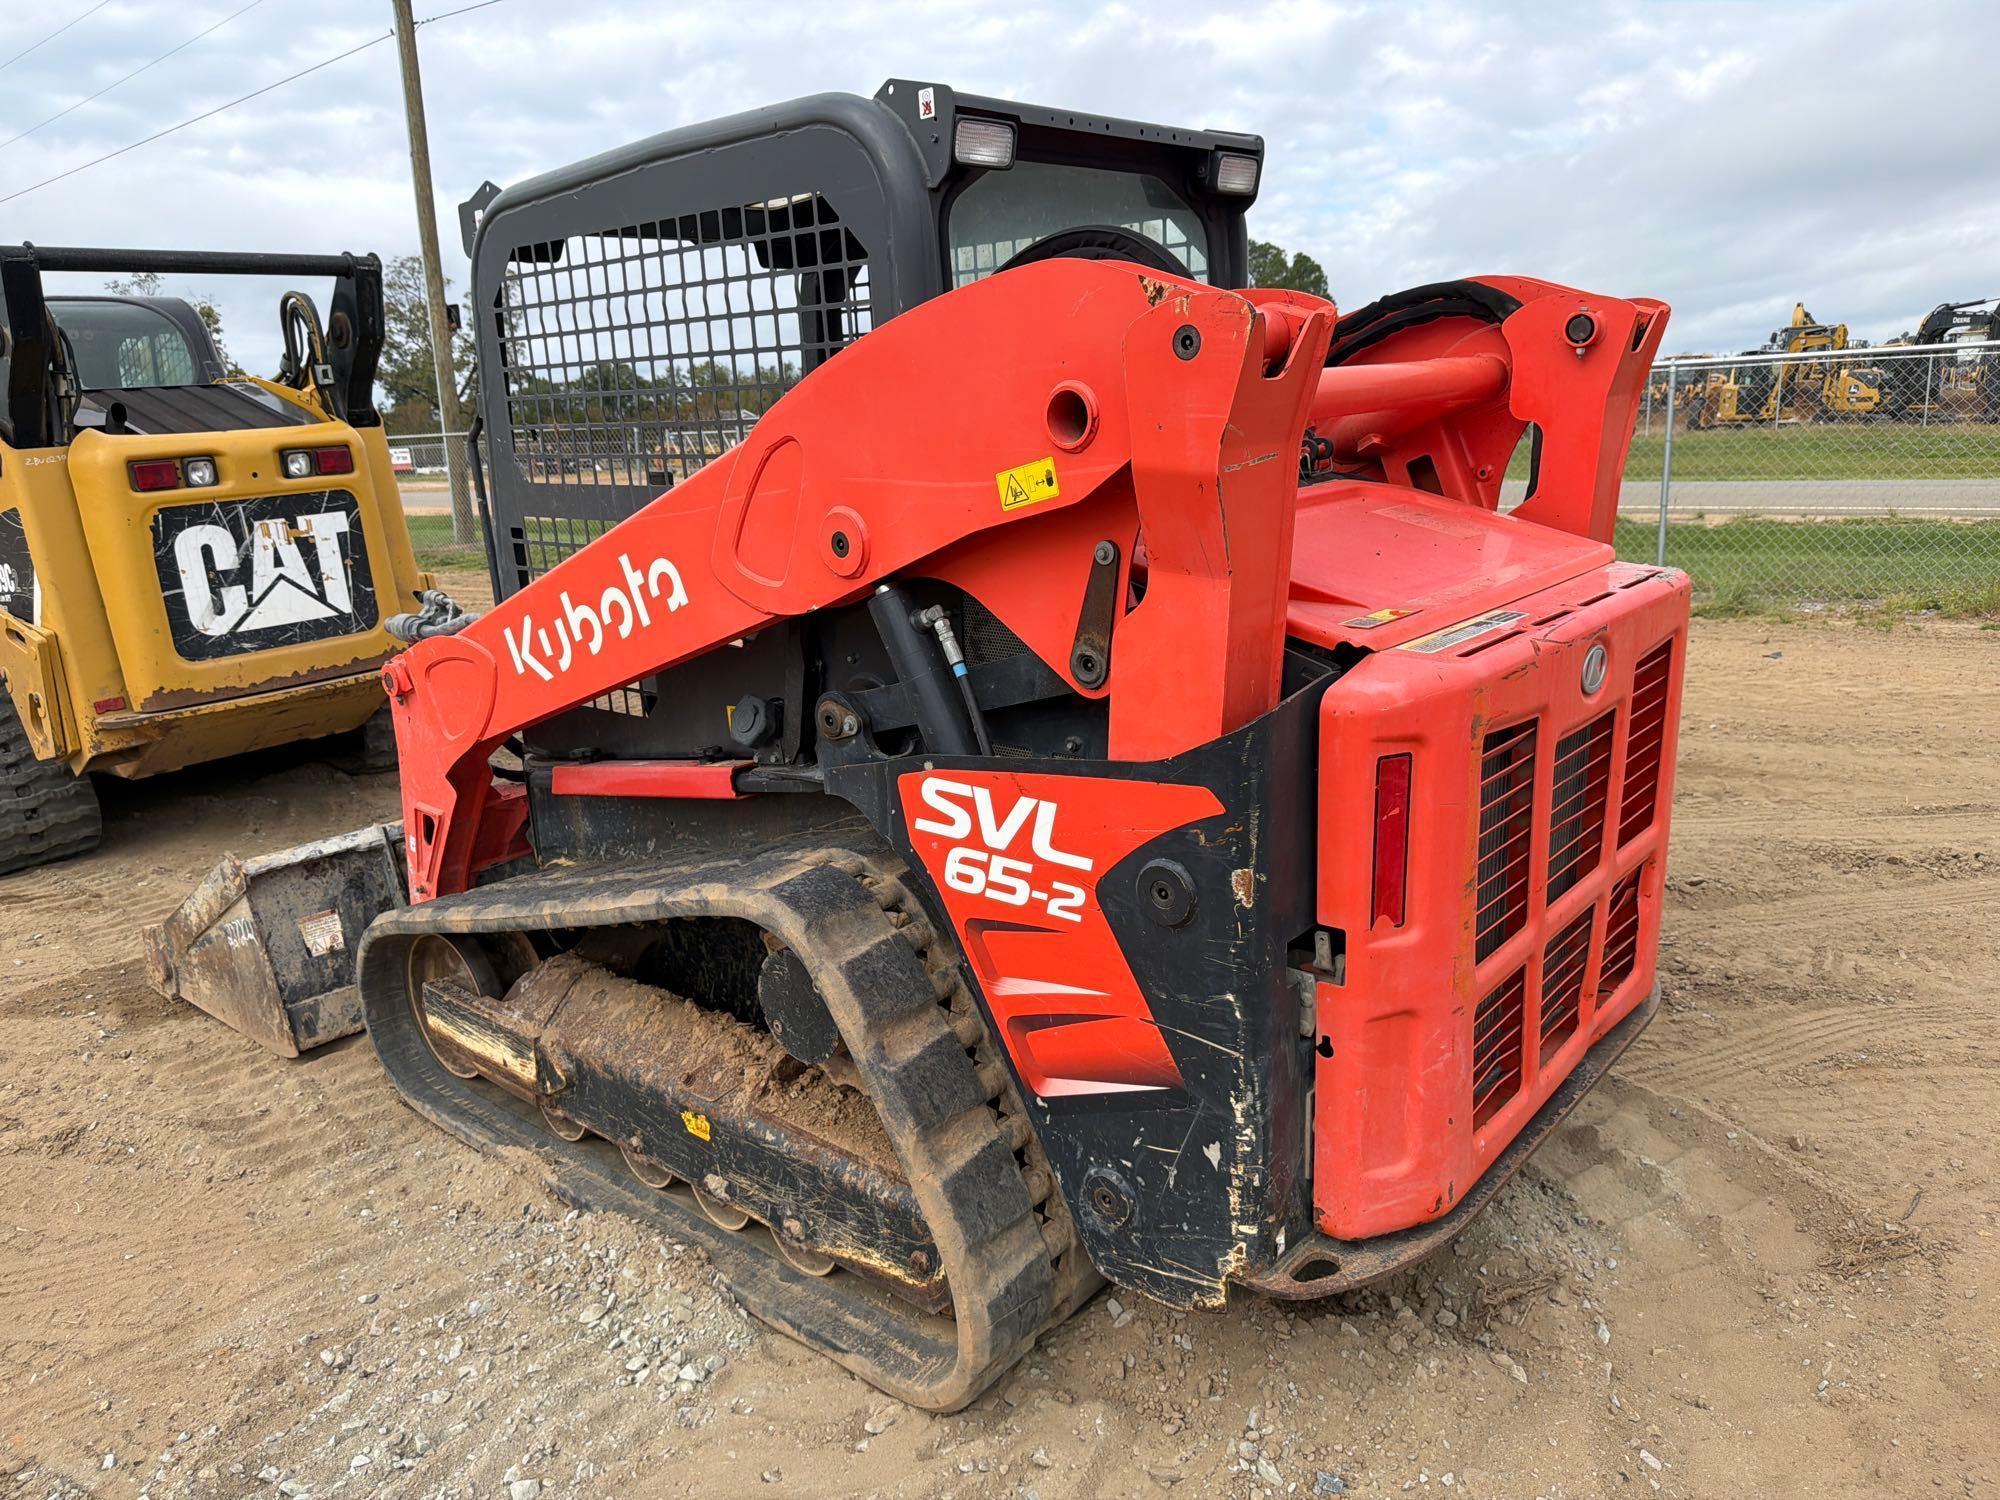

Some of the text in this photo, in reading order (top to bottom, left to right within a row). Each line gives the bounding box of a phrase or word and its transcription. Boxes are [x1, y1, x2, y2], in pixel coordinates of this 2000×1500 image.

[174, 511, 353, 636] CAT
[503, 553, 689, 681] Kubota
[914, 777, 1095, 871] SVL
[944, 847, 1086, 923] 65-2
